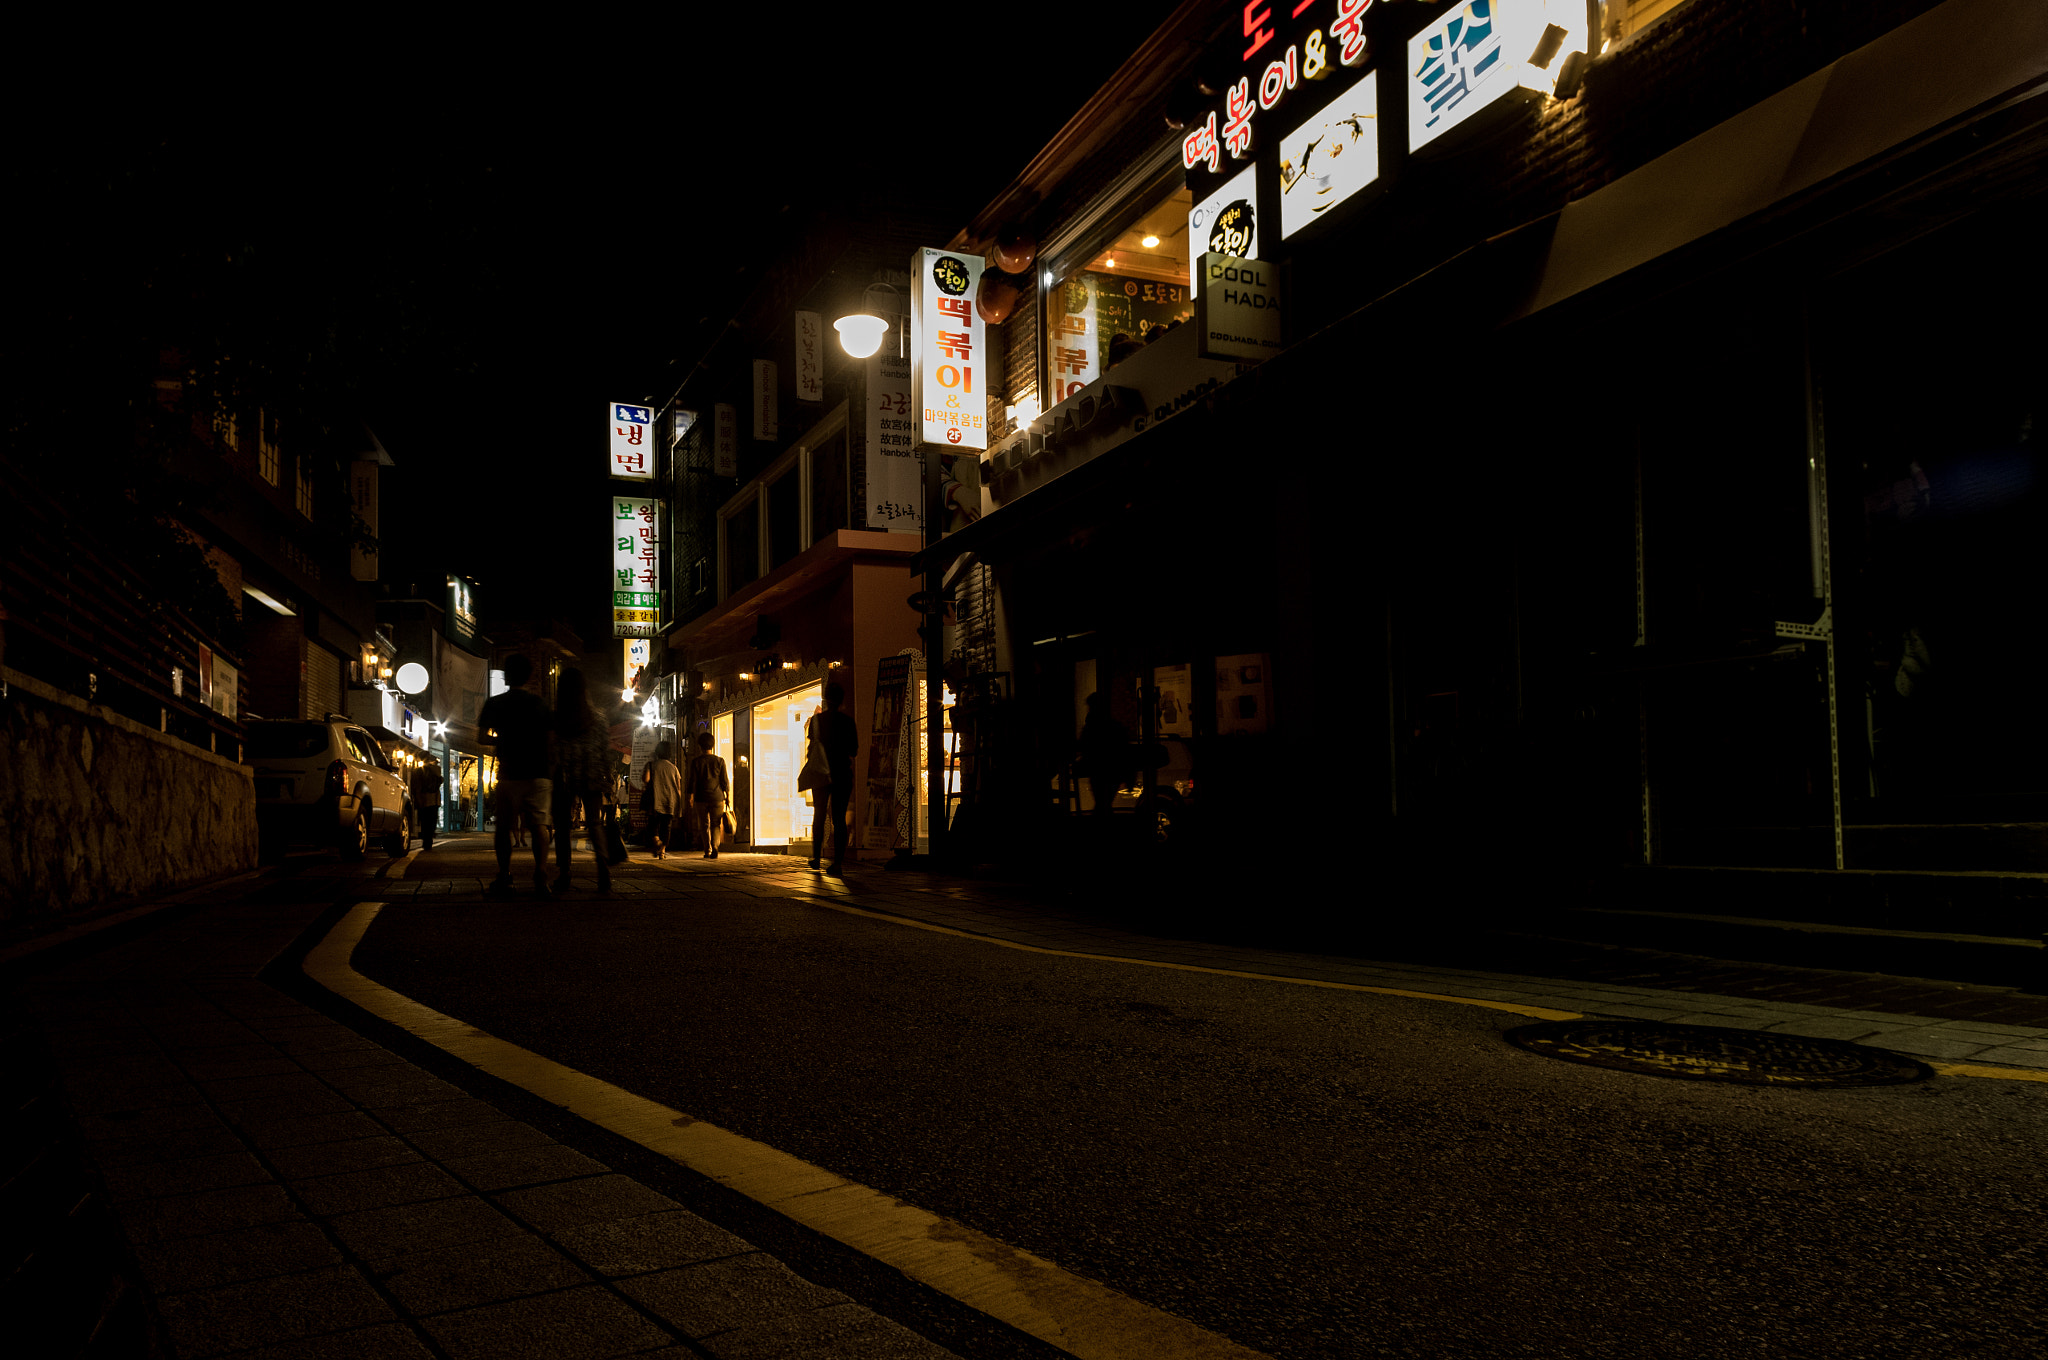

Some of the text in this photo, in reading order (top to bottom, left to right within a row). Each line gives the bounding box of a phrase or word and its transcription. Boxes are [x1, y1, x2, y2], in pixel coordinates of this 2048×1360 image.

[934, 268, 966, 292] 달인
[1210, 264, 1267, 287] COOL
[1224, 289, 1280, 311] HADA
[935, 297, 973, 394] 떡볶이
[1210, 331, 1281, 348] COOLHADA.COM
[945, 394, 961, 409] &
[880, 418, 917, 431] 故宮体
[925, 408, 983, 429] 마약볶음밥
[949, 430, 961, 441] 2F
[616, 424, 647, 474] 냉면
[880, 448, 911, 458] Hanbok
[616, 503, 636, 587] 보리밥
